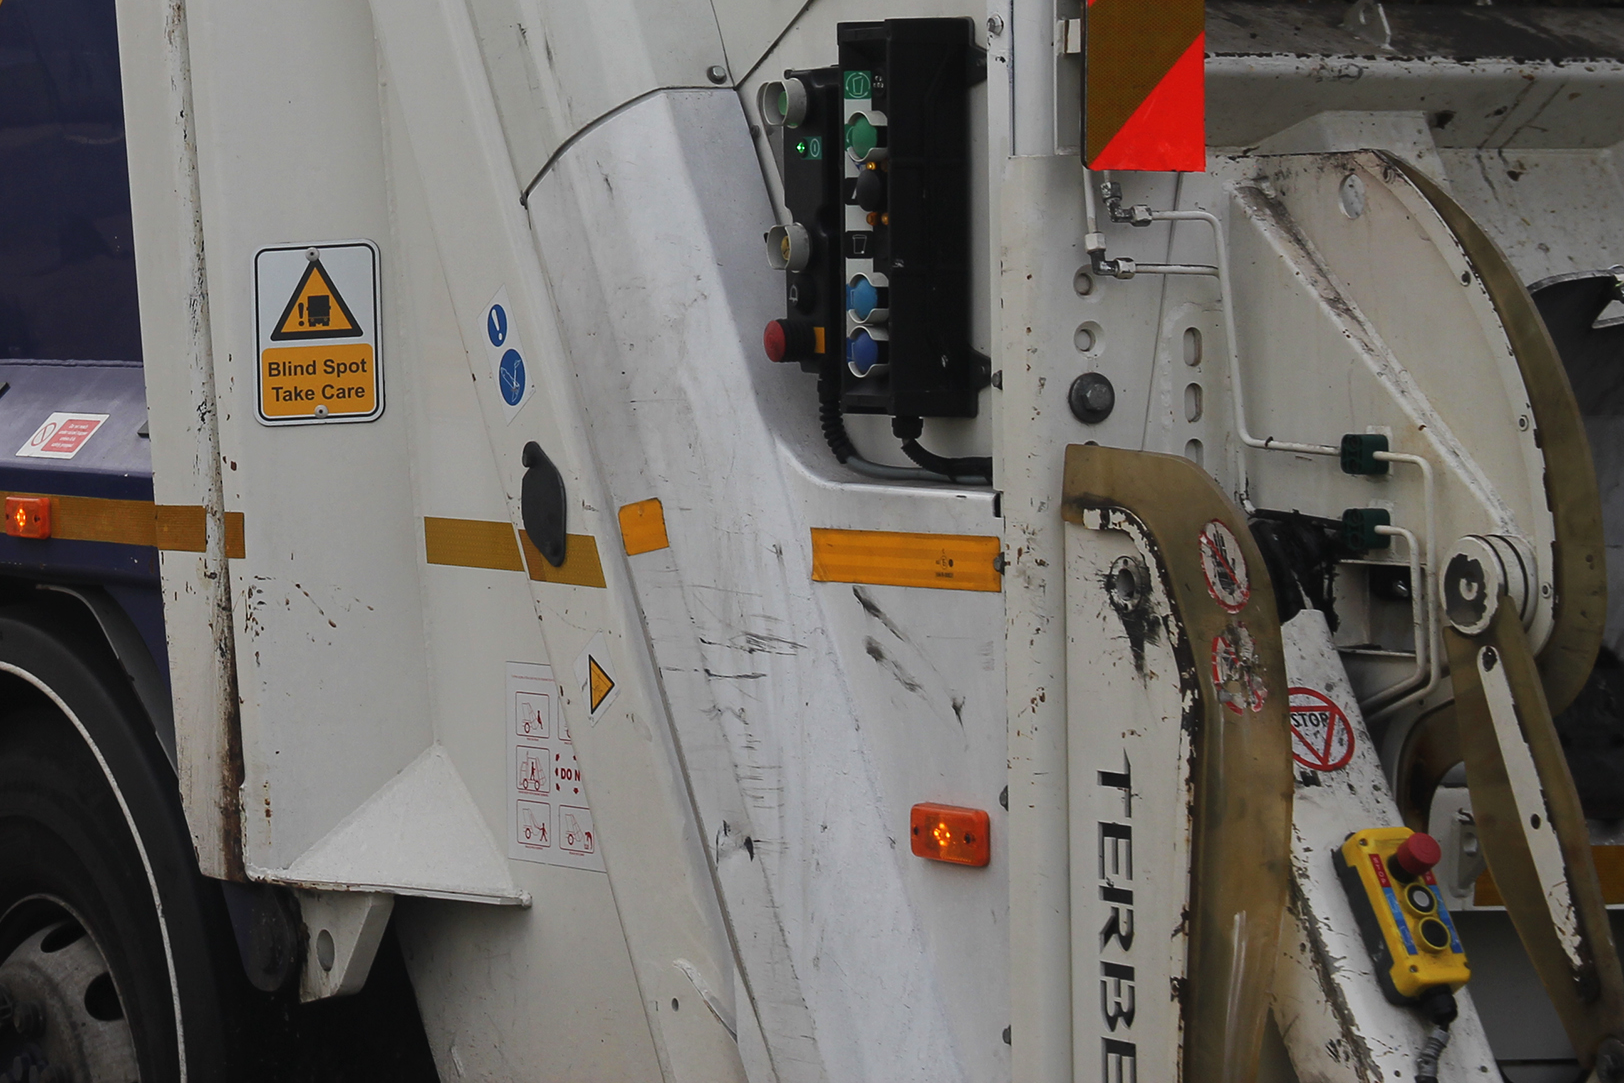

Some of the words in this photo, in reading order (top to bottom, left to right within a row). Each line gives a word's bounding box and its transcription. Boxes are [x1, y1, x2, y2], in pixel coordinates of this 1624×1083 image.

[268, 360, 316, 377] Blind
[323, 358, 367, 377] Spot
[271, 385, 316, 402] Take
[321, 383, 366, 400] Care
[1290, 712, 1329, 728] STOP
[560, 768, 572, 781] DO
[1096, 747, 1138, 1083] TERBE
